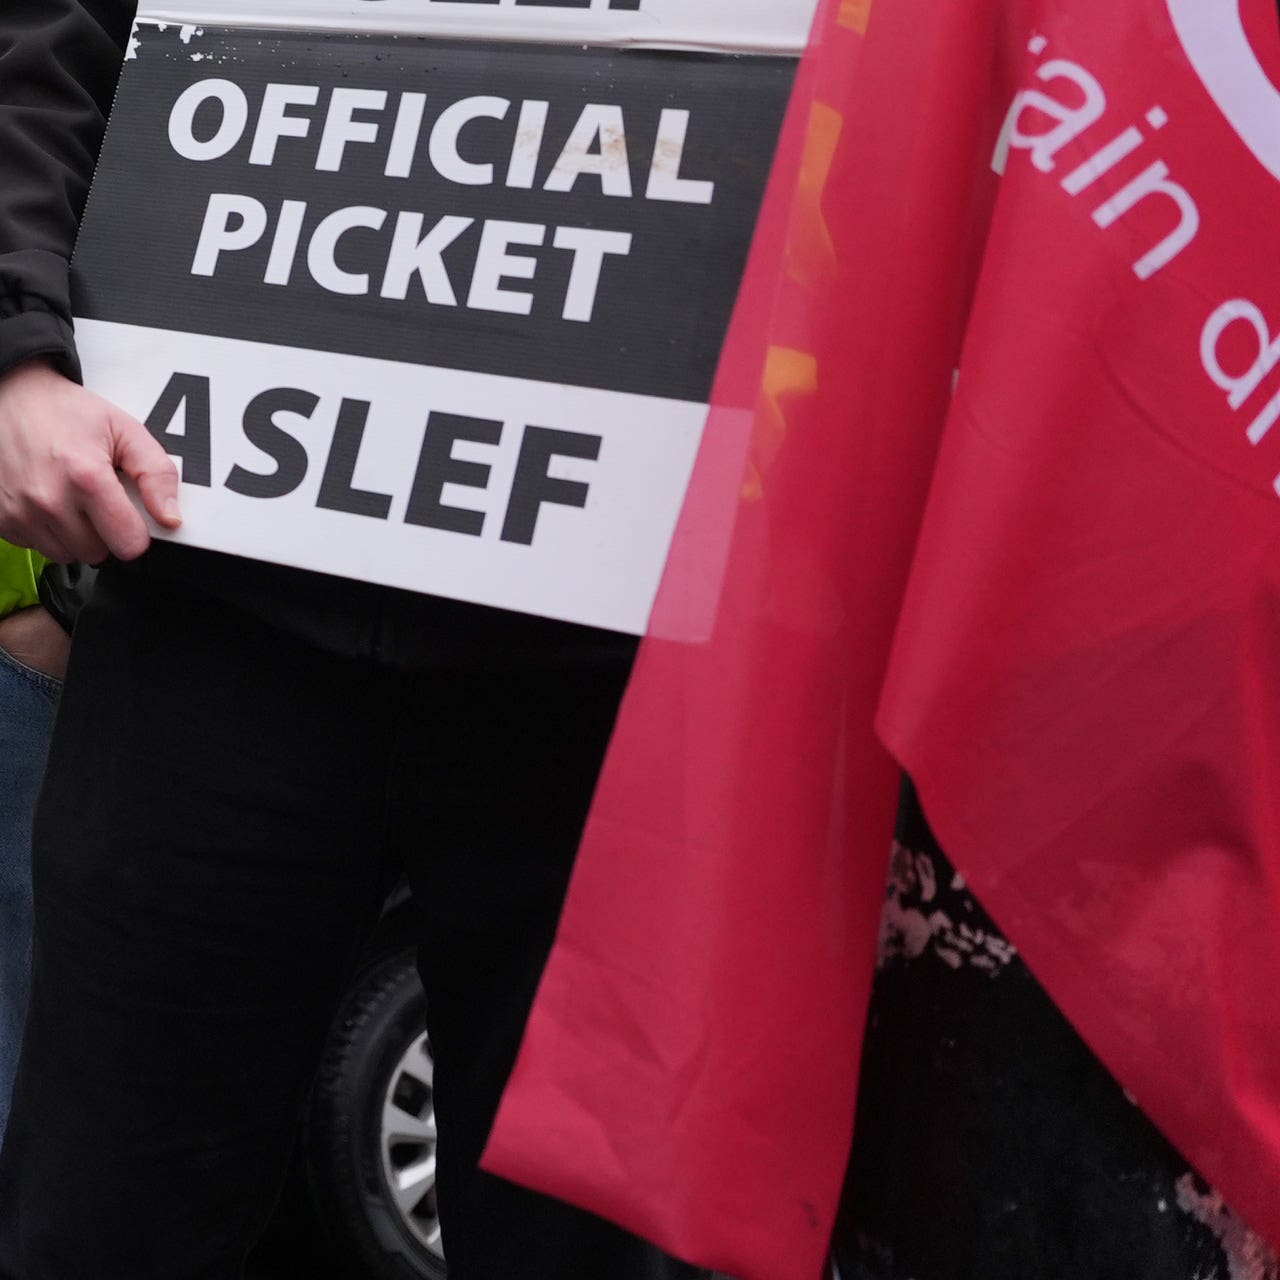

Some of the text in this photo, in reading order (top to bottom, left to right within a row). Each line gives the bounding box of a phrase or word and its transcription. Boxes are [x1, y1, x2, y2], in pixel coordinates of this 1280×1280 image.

[167, 78, 716, 205] OFFICIAL
[190, 192, 634, 324] PICKET
[143, 370, 604, 547] ASLEF
